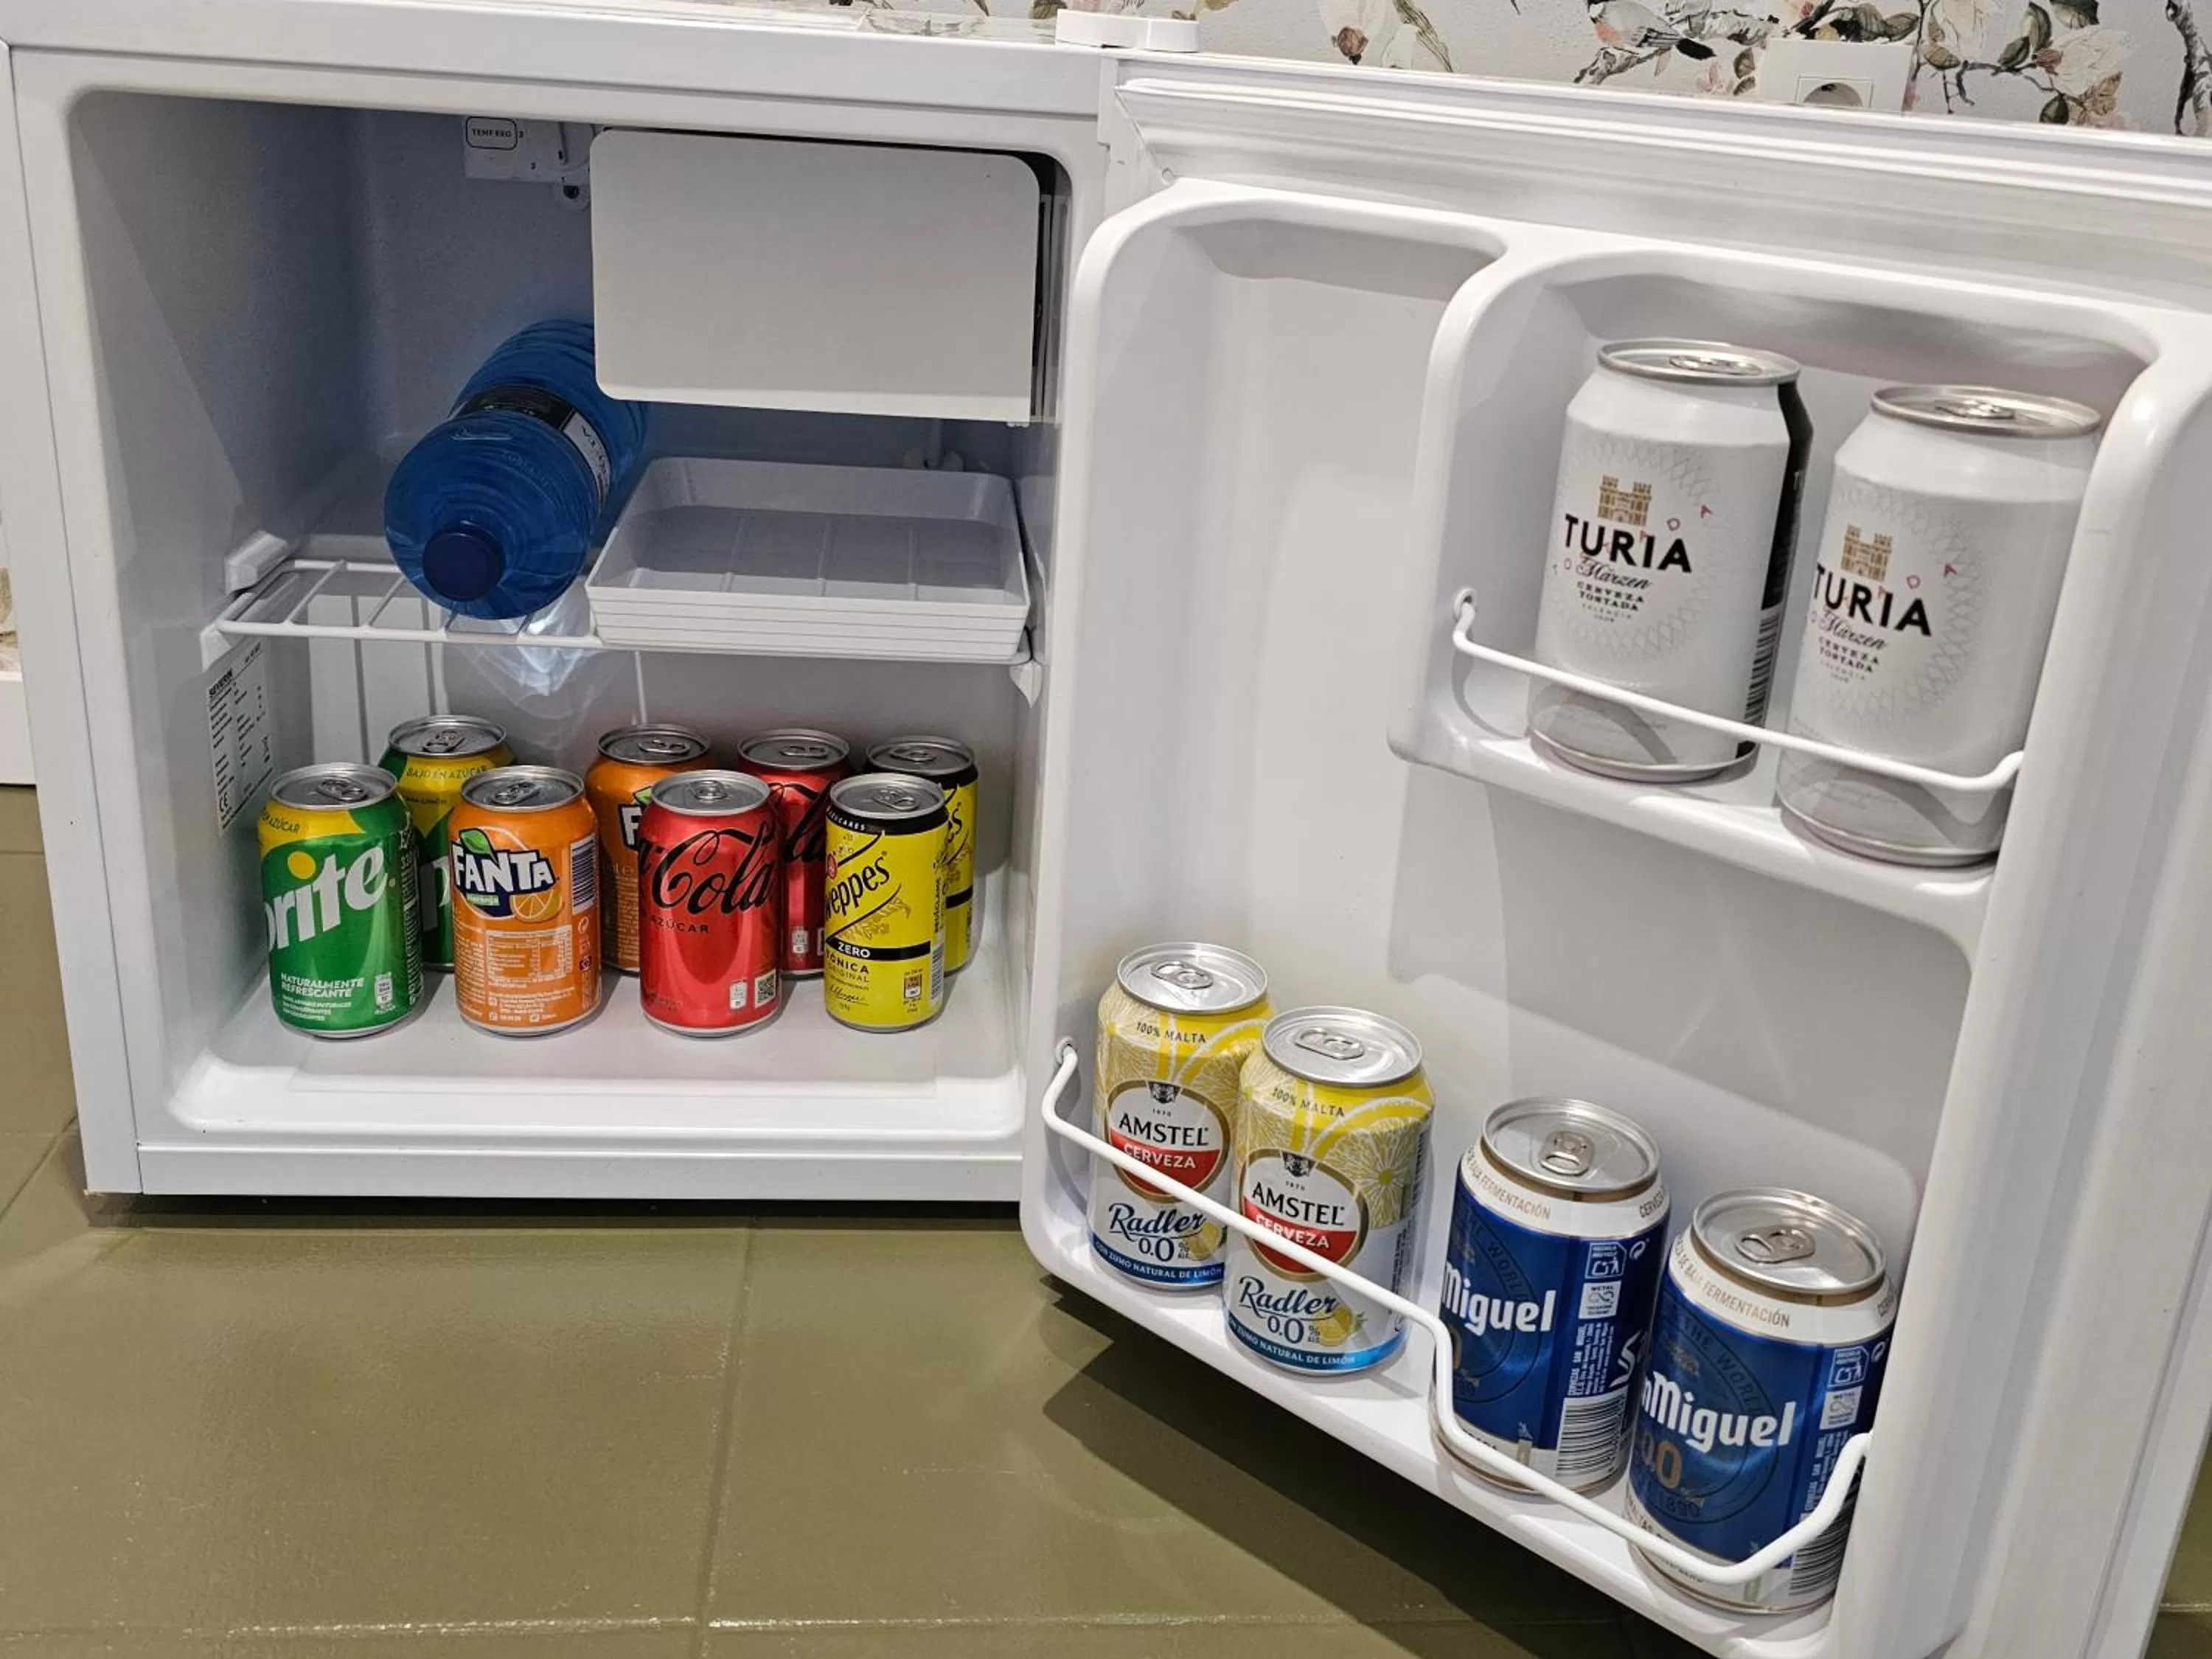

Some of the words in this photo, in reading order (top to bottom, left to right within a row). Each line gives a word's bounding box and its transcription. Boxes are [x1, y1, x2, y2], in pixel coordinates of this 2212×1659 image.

[1565, 513, 1692, 574] TURIA
[1577, 581, 1644, 603] CERVEZA
[1814, 563, 1932, 637] TURIA
[1818, 636, 1879, 665] CERVEZA
[406, 767, 431, 779] BAJO
[452, 844, 554, 893] FANTA
[265, 844, 389, 951] rite
[825, 855, 891, 922] eppes
[838, 942, 871, 959] ZERO
[281, 972, 365, 989] NATURALMENTE
[281, 981, 353, 998] REFRESCANTE
[1136, 1022, 1160, 1037] 100%
[1165, 1029, 1206, 1043] MALTA
[1272, 1088, 1296, 1105] 100%
[1301, 1099, 1344, 1117] MALTA
[1119, 1112, 1208, 1146] AMSTEL
[1123, 1142, 1196, 1168] CERVEZA
[1252, 1181, 1345, 1225] AMSTEL
[1108, 1203, 1207, 1242] Radler
[1256, 1214, 1329, 1248] CERVEZA
[1133, 1264, 1176, 1279] NATURAL
[1179, 1270, 1191, 1279] DE
[1239, 1276, 1340, 1318] Radler
[1702, 1281, 1790, 1328] FERMENTACIÓN
[1259, 1341, 1304, 1361] NATURAL
